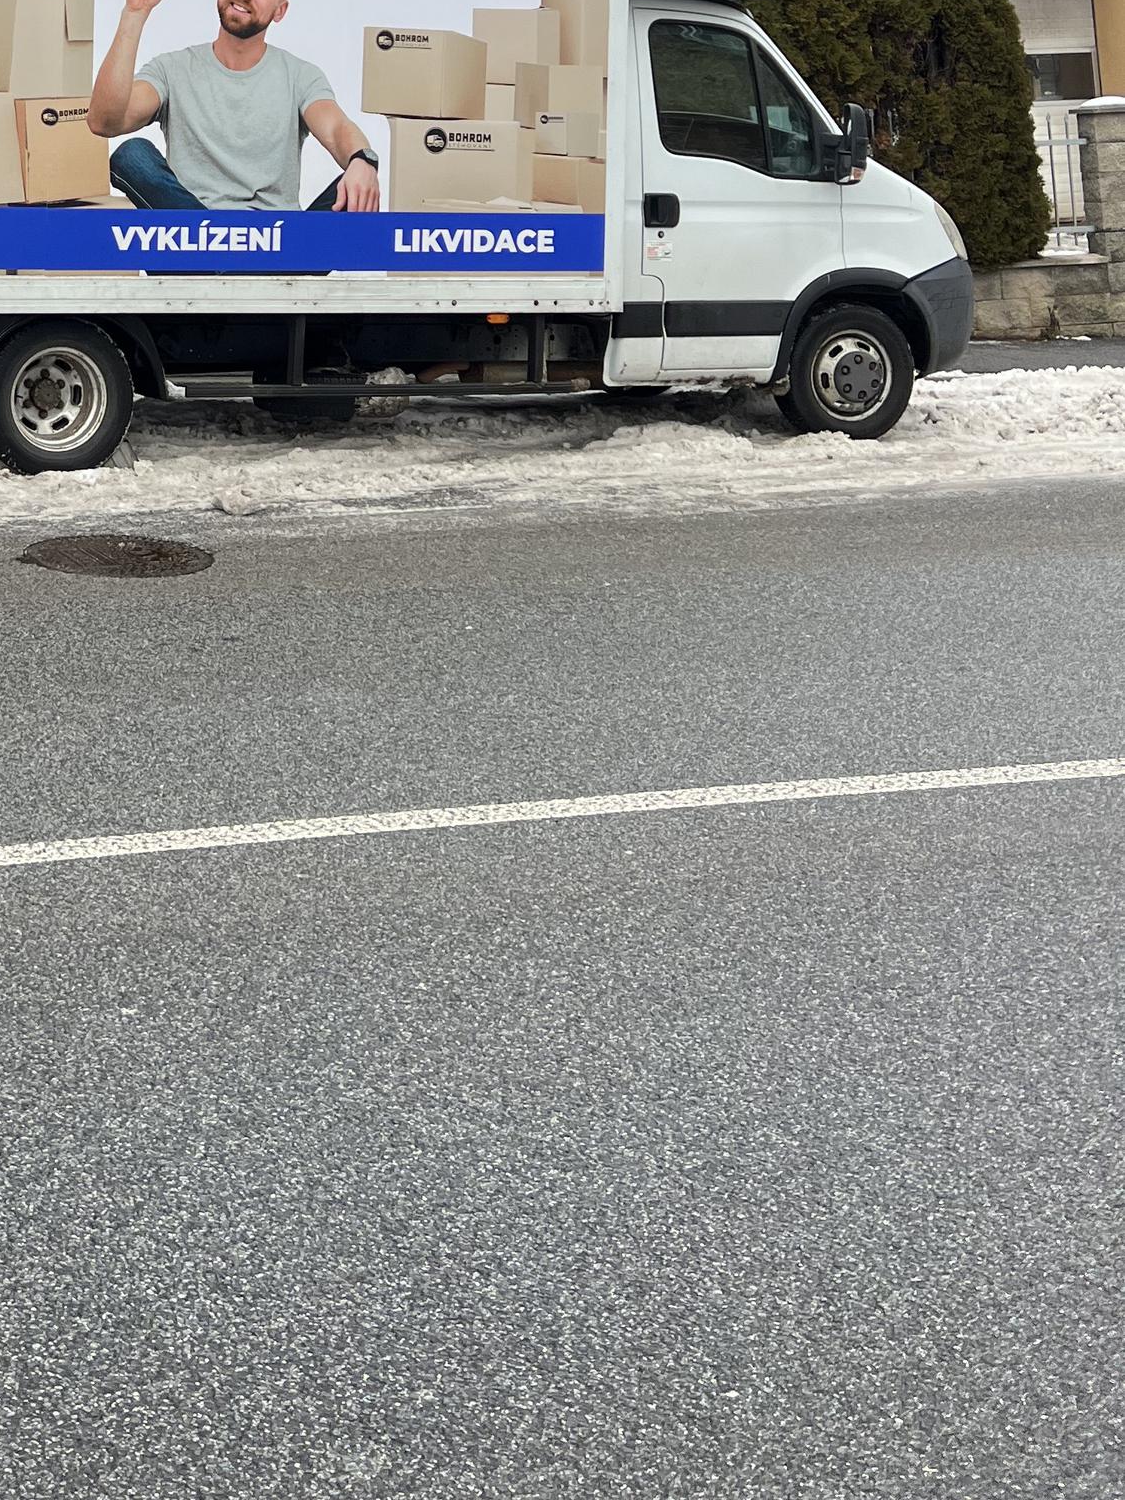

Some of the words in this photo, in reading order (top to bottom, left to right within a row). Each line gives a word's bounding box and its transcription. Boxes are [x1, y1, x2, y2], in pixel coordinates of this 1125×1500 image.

[395, 34, 429, 43] BOHROM
[448, 132, 492, 143] BOHROM
[111, 219, 283, 253] VYKLÍZENÍ
[394, 229, 555, 253] LIKVIDACE
